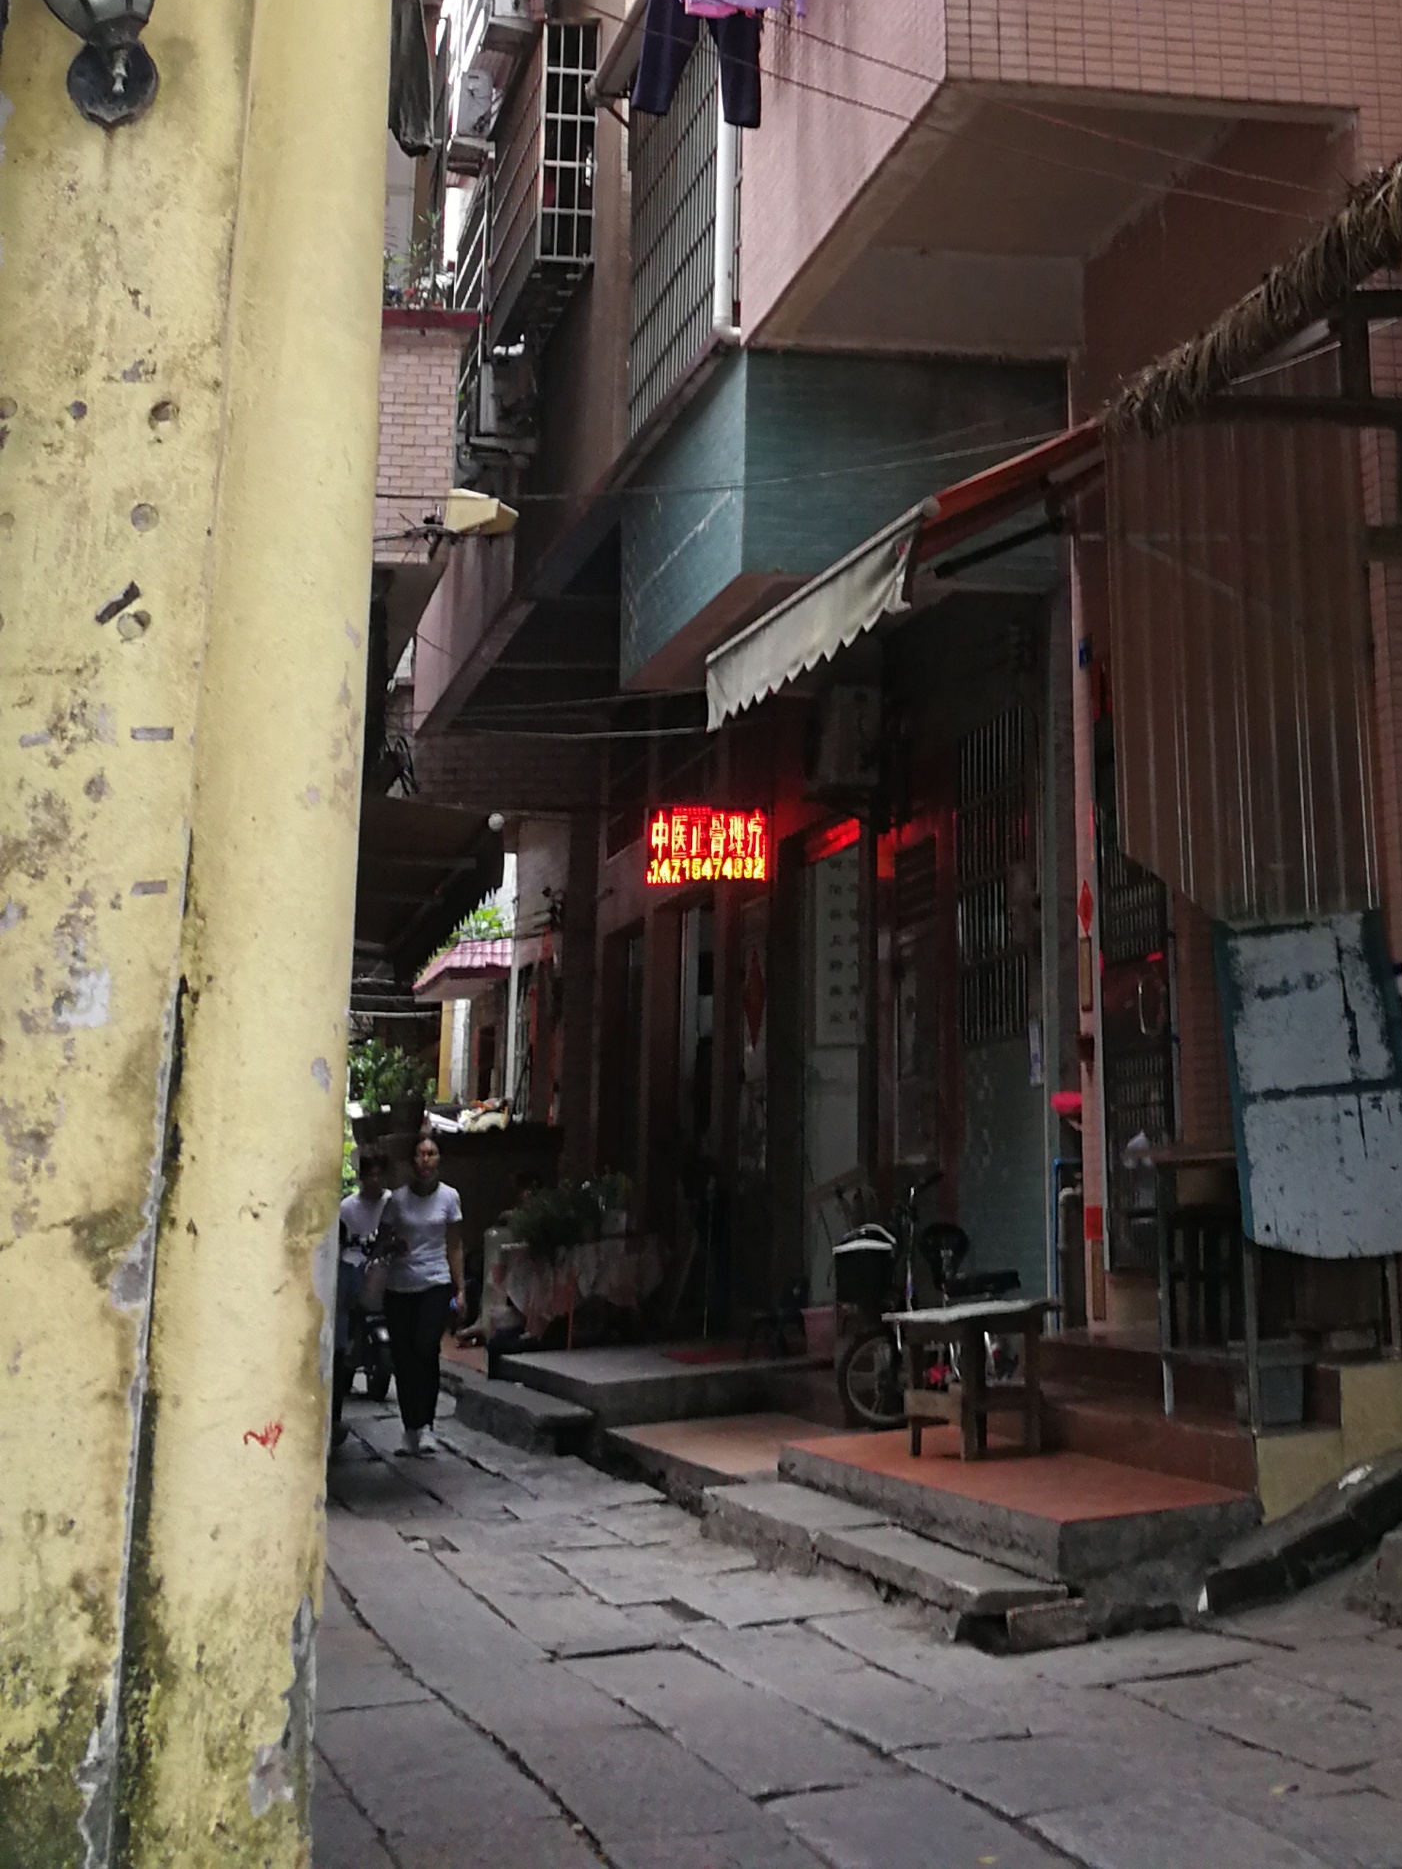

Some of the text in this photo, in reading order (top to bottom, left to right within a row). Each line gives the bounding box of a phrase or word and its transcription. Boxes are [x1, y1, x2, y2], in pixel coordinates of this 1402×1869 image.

[651, 809, 766, 860] 中医正骨理疗
